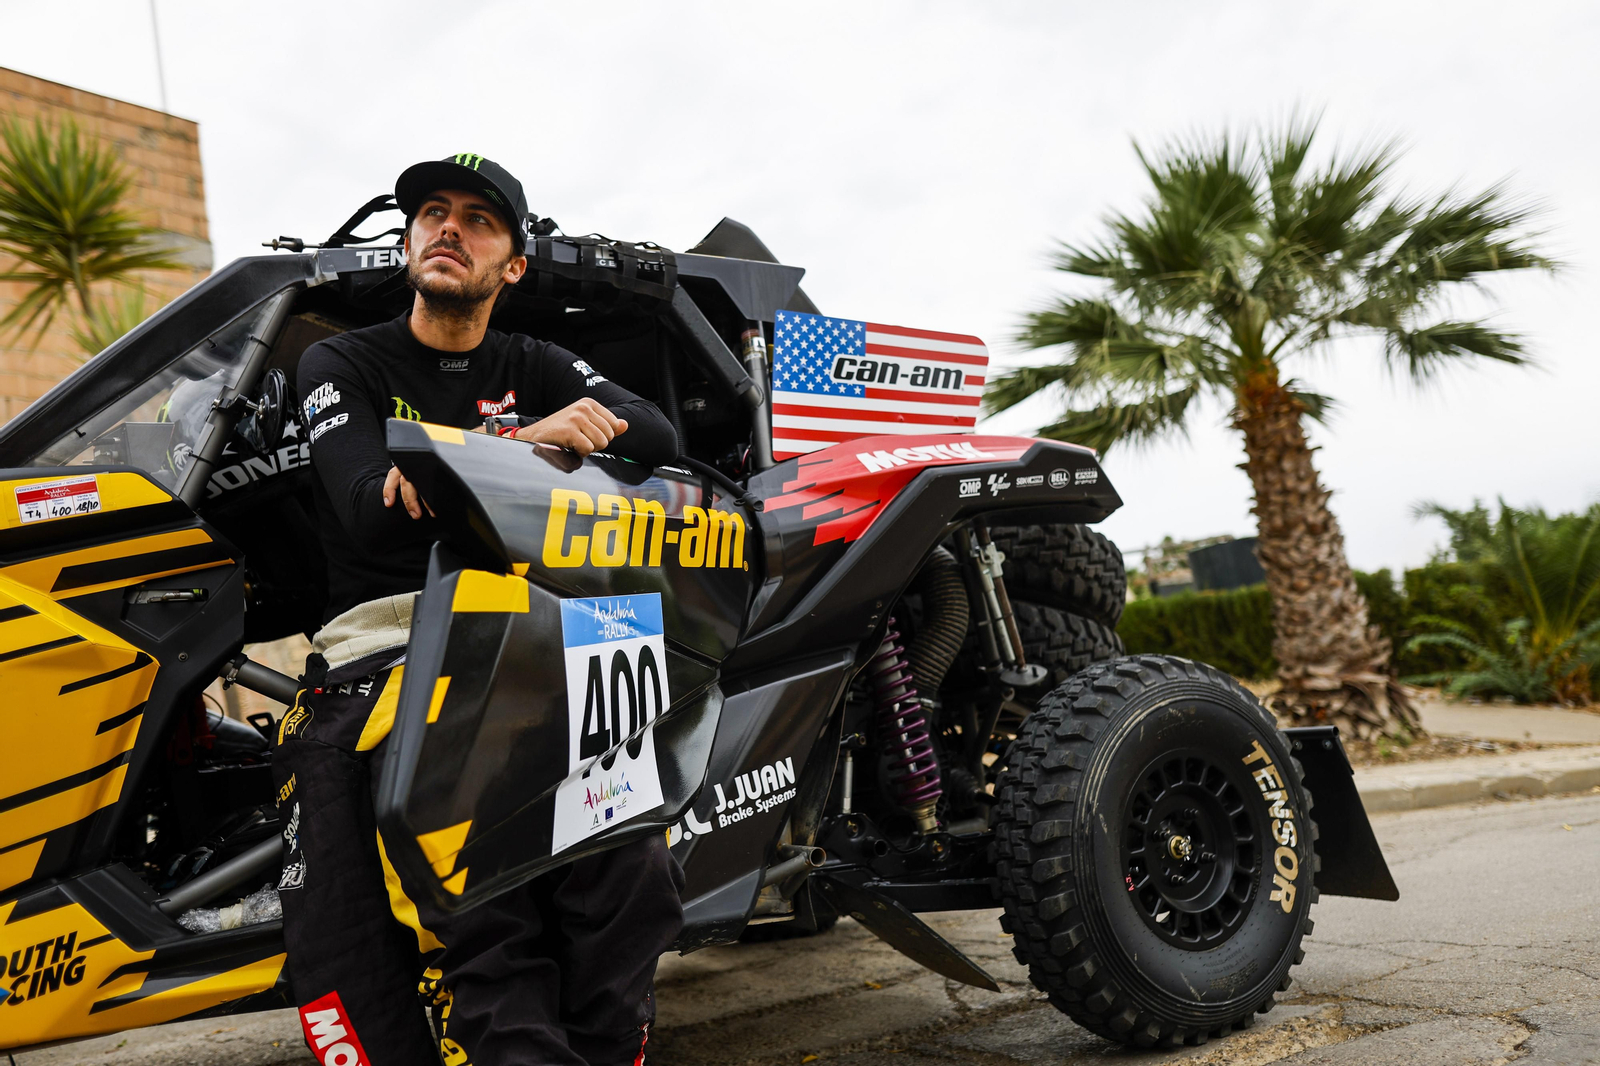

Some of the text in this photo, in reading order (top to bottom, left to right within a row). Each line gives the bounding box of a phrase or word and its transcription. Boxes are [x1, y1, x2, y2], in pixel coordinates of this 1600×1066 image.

[440, 359, 469, 370] OMP
[833, 356, 963, 390] can-am
[481, 391, 516, 415] MOTUL
[856, 442, 995, 473] MOTUL
[959, 479, 982, 496] OMP
[1051, 472, 1068, 483] BELL
[52, 506, 71, 516] 400
[76, 500, 99, 513] 18/10
[542, 488, 746, 569] can-am
[604, 622, 629, 640] RALLY
[579, 644, 662, 780] 400
[713, 756, 796, 814] J.JUAN
[718, 806, 755, 829] Brake
[755, 787, 797, 814] Systems
[1242, 740, 1300, 914] TENSOR
[305, 1008, 363, 1066] MO
